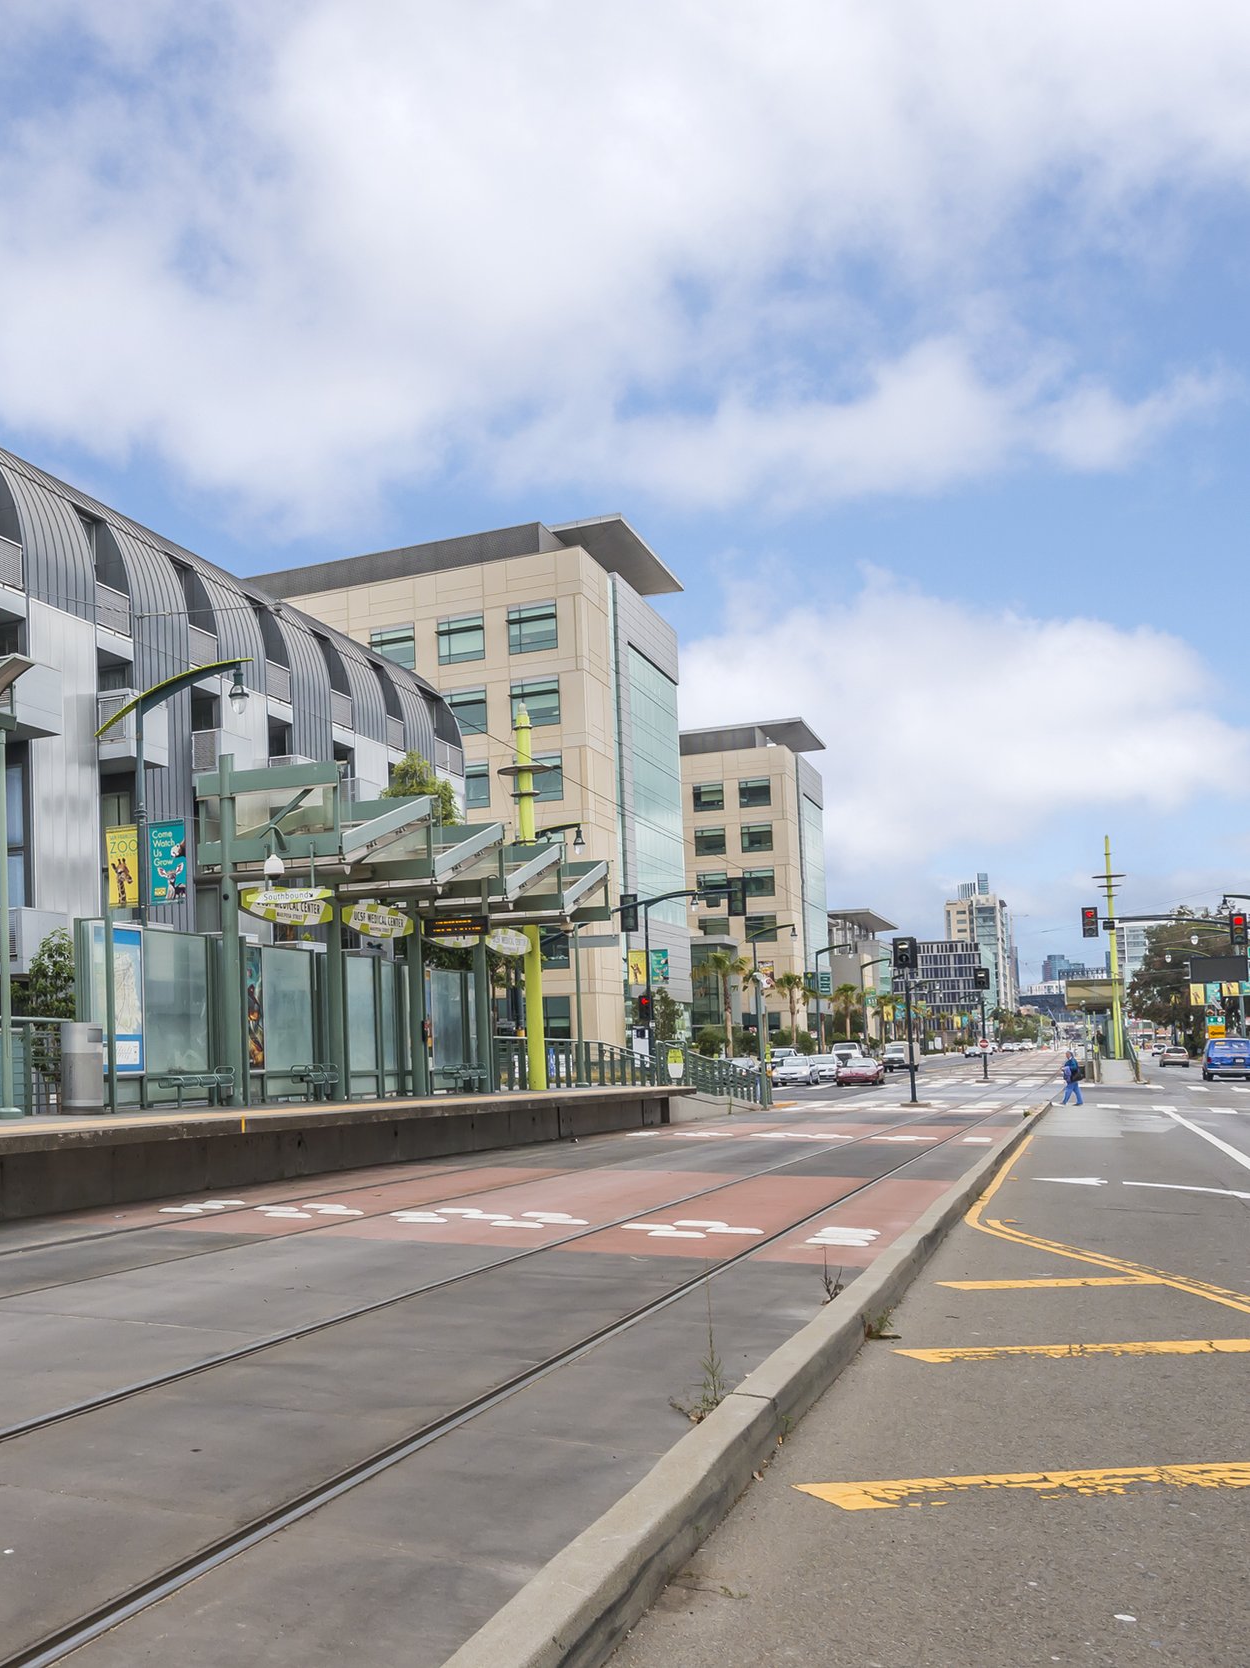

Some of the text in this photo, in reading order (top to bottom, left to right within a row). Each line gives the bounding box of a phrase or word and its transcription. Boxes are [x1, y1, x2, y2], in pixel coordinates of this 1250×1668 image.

[152, 830, 173, 839] Come
[110, 839, 138, 854] ZOO
[153, 838, 176, 848] Watch
[153, 849, 163, 857] Us
[154, 858, 174, 867] Grow
[263, 891, 309, 901] Southbound
[301, 902, 321, 915] CENTER
[353, 911, 404, 928] UCSF MEDICAL CENTER
